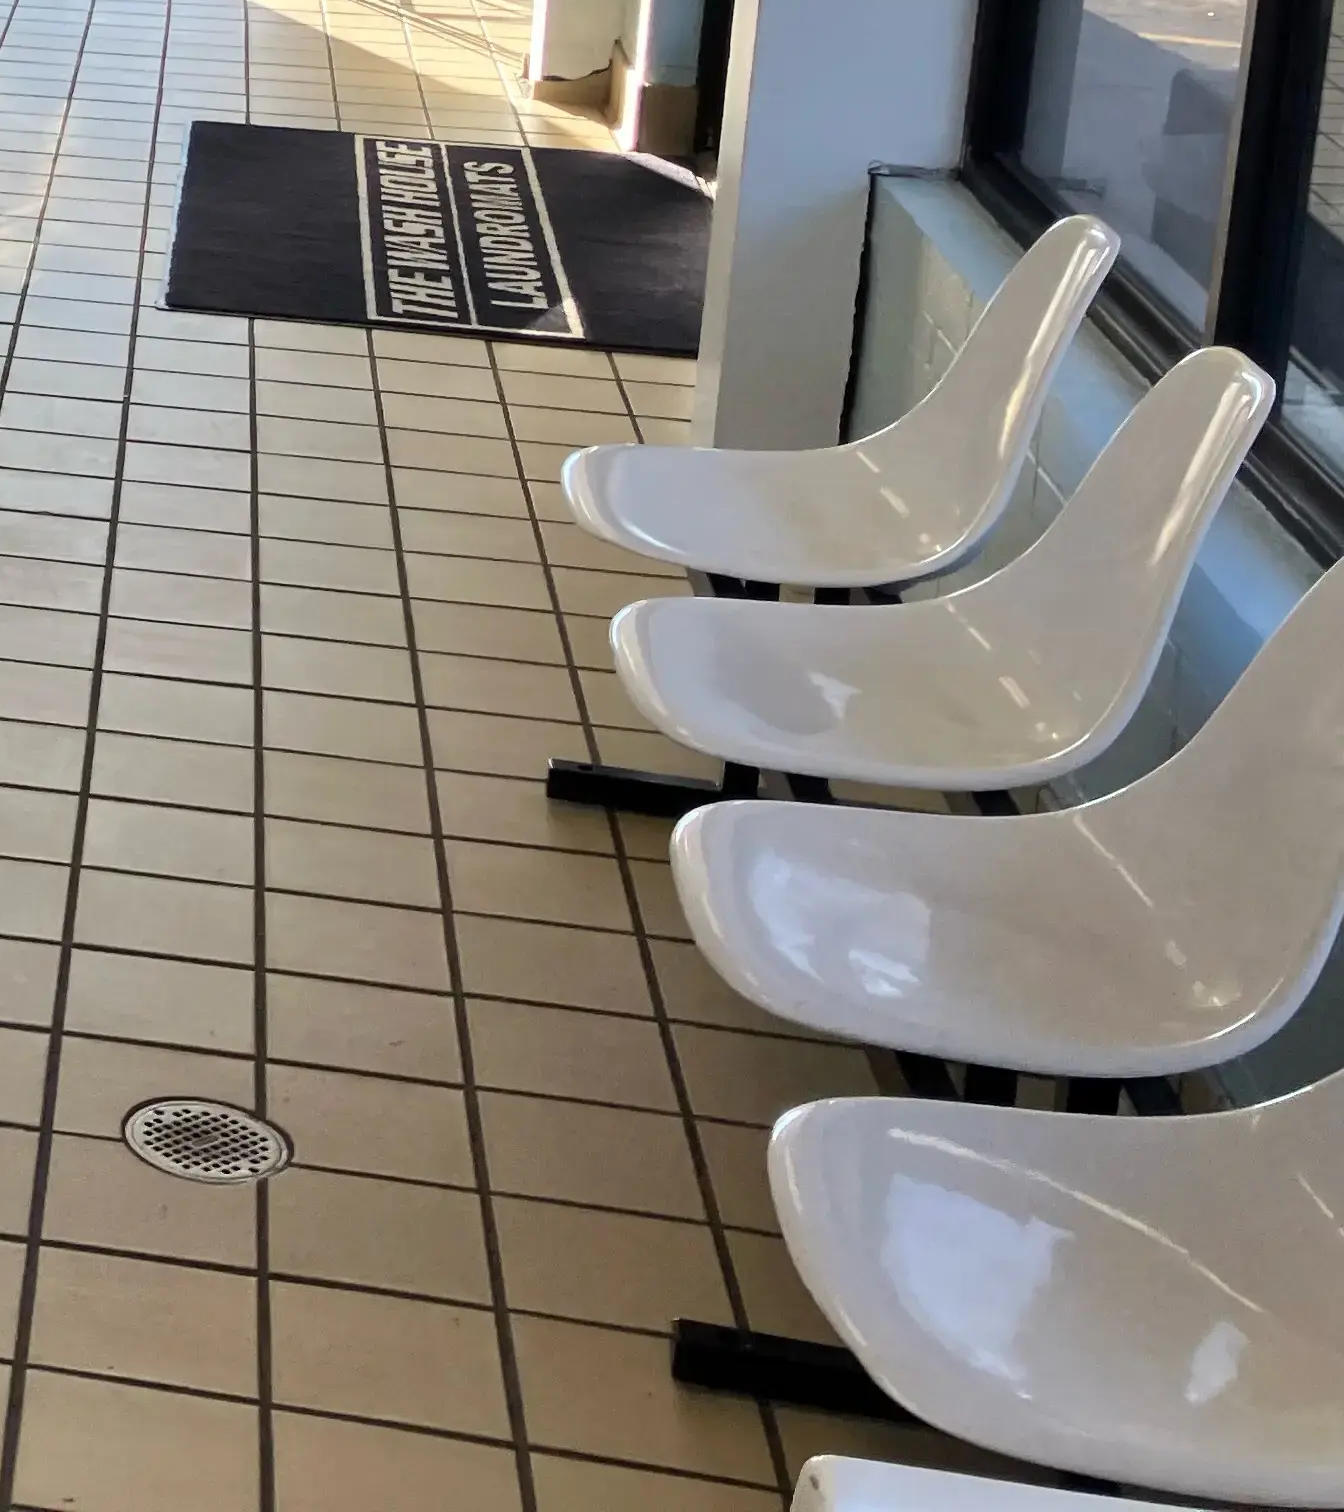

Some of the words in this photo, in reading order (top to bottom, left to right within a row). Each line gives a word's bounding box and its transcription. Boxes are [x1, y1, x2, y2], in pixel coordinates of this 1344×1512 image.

[376, 141, 441, 207] HOUSE
[382, 204, 450, 271] WASH
[463, 161, 549, 309] LAUNDROMATS
[388, 268, 459, 318] THE
